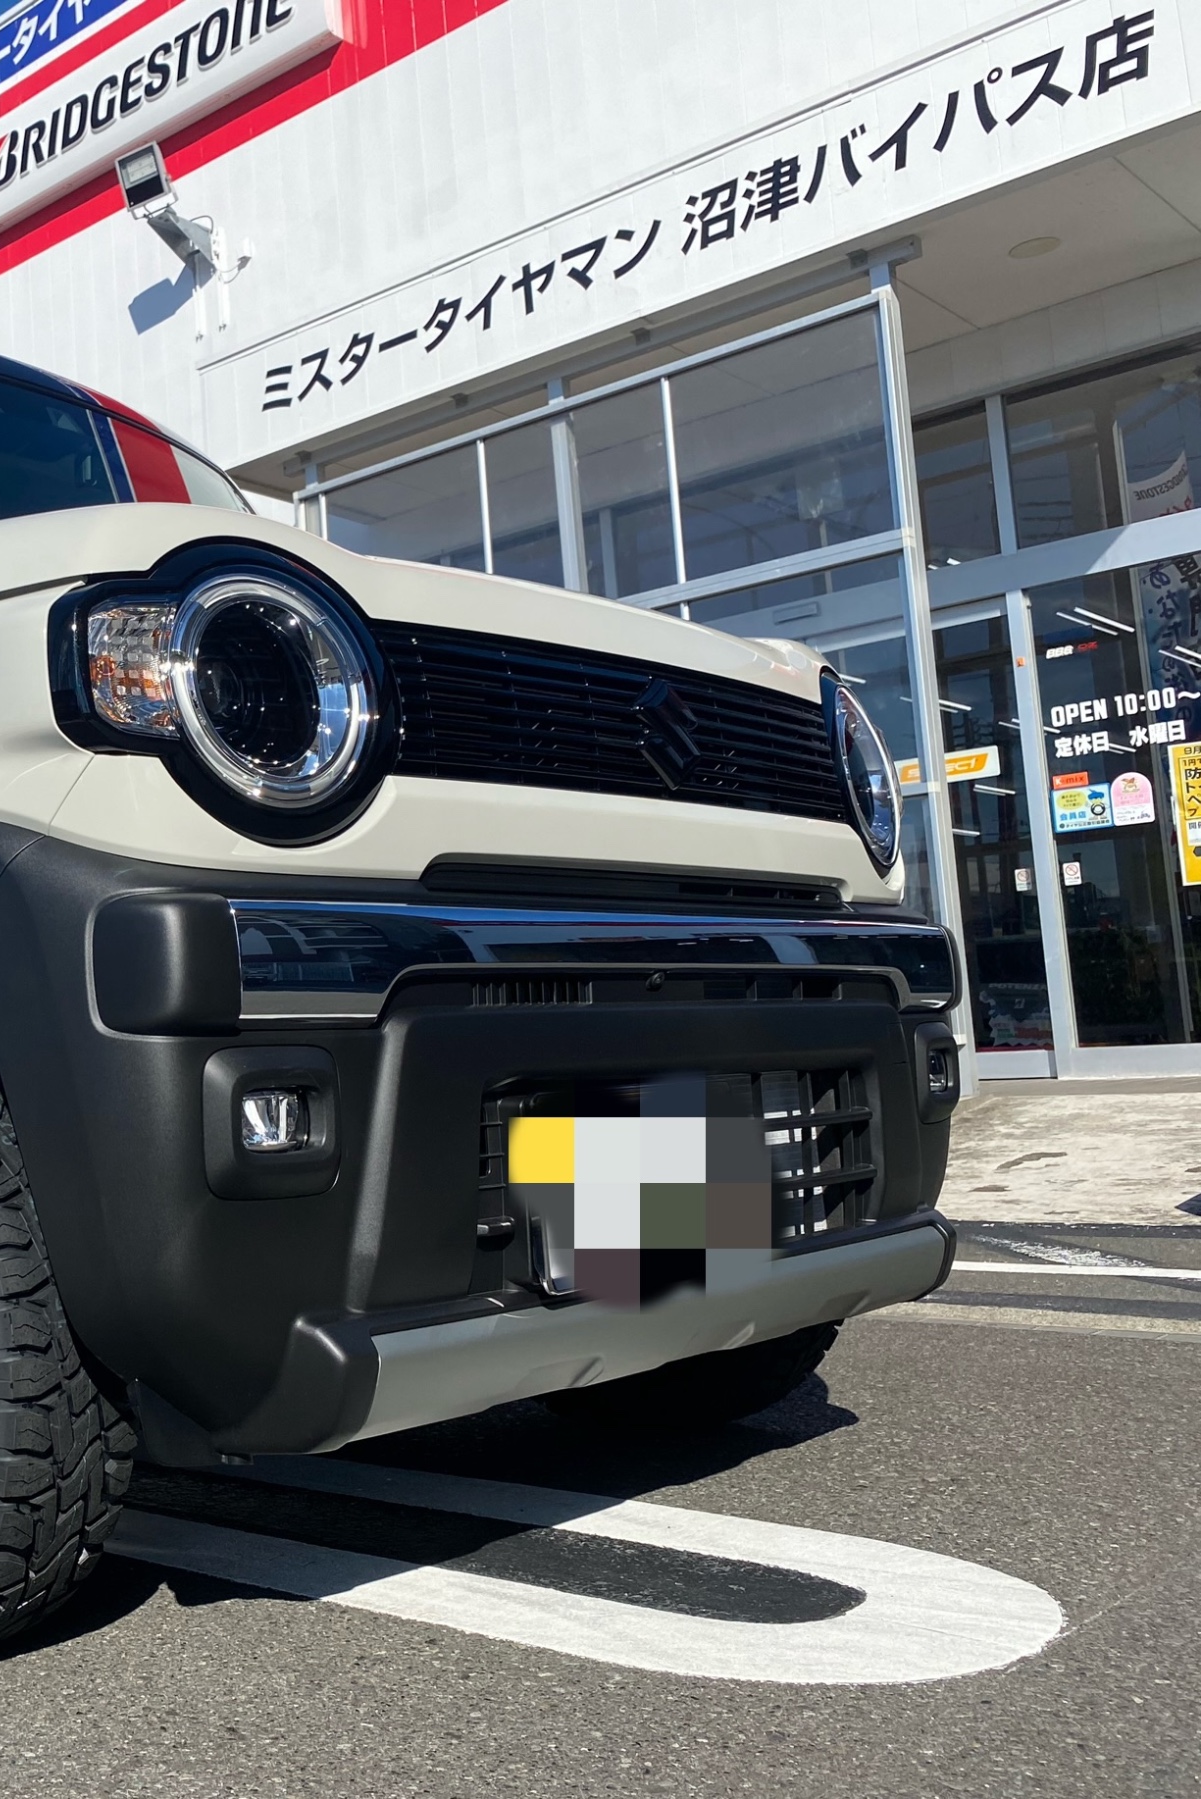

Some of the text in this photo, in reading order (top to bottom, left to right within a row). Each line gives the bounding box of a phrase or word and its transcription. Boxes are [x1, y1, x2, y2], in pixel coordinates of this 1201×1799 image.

[262, 9, 1155, 412] ミスタータイヤマン 沼津バイパス店
[1051, 698, 1108, 728] OPEN
[1054, 719, 1186, 758] 定休日 水曜日
